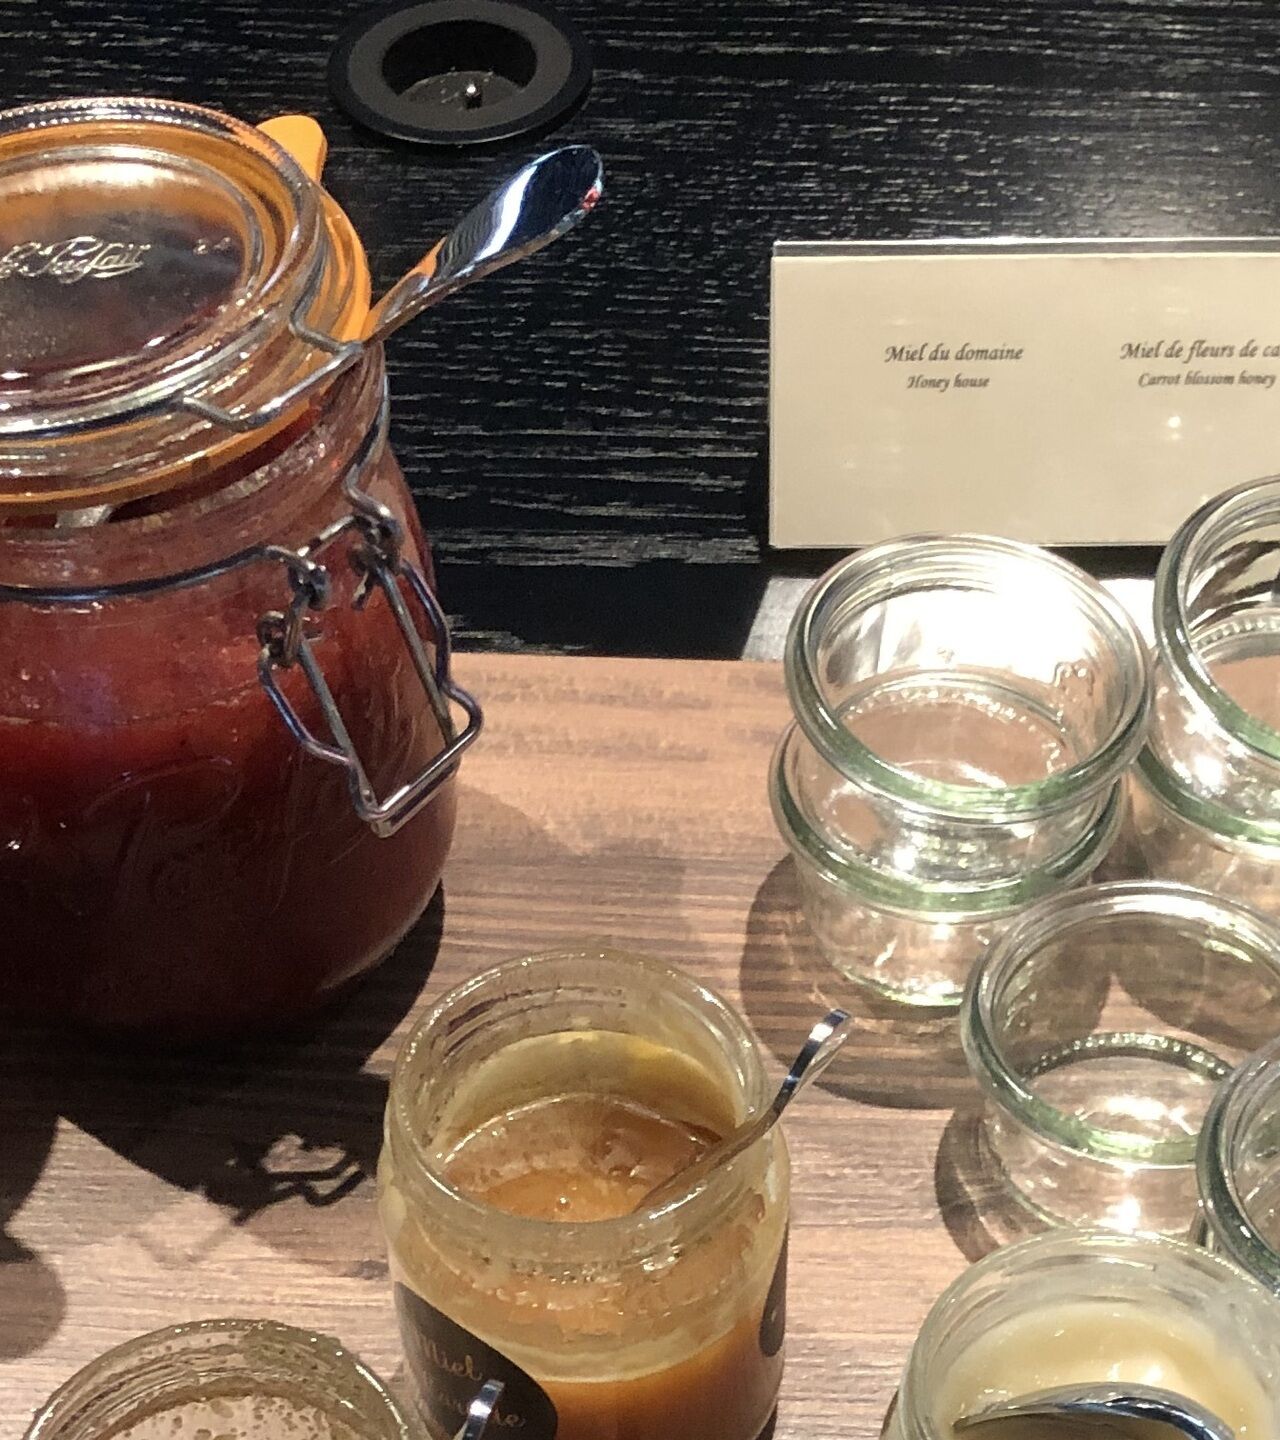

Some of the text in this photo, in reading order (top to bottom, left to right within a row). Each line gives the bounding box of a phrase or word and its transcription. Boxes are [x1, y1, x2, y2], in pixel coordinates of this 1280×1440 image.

[884, 342, 1024, 362] Miel du domaine
[1120, 340, 1165, 359] Miel
[1164, 340, 1183, 358] de
[1182, 339, 1235, 363] fleurs
[1239, 339, 1258, 358] de
[907, 372, 991, 392] Honey house
[1138, 370, 1277, 388] Carrot blossom honey
